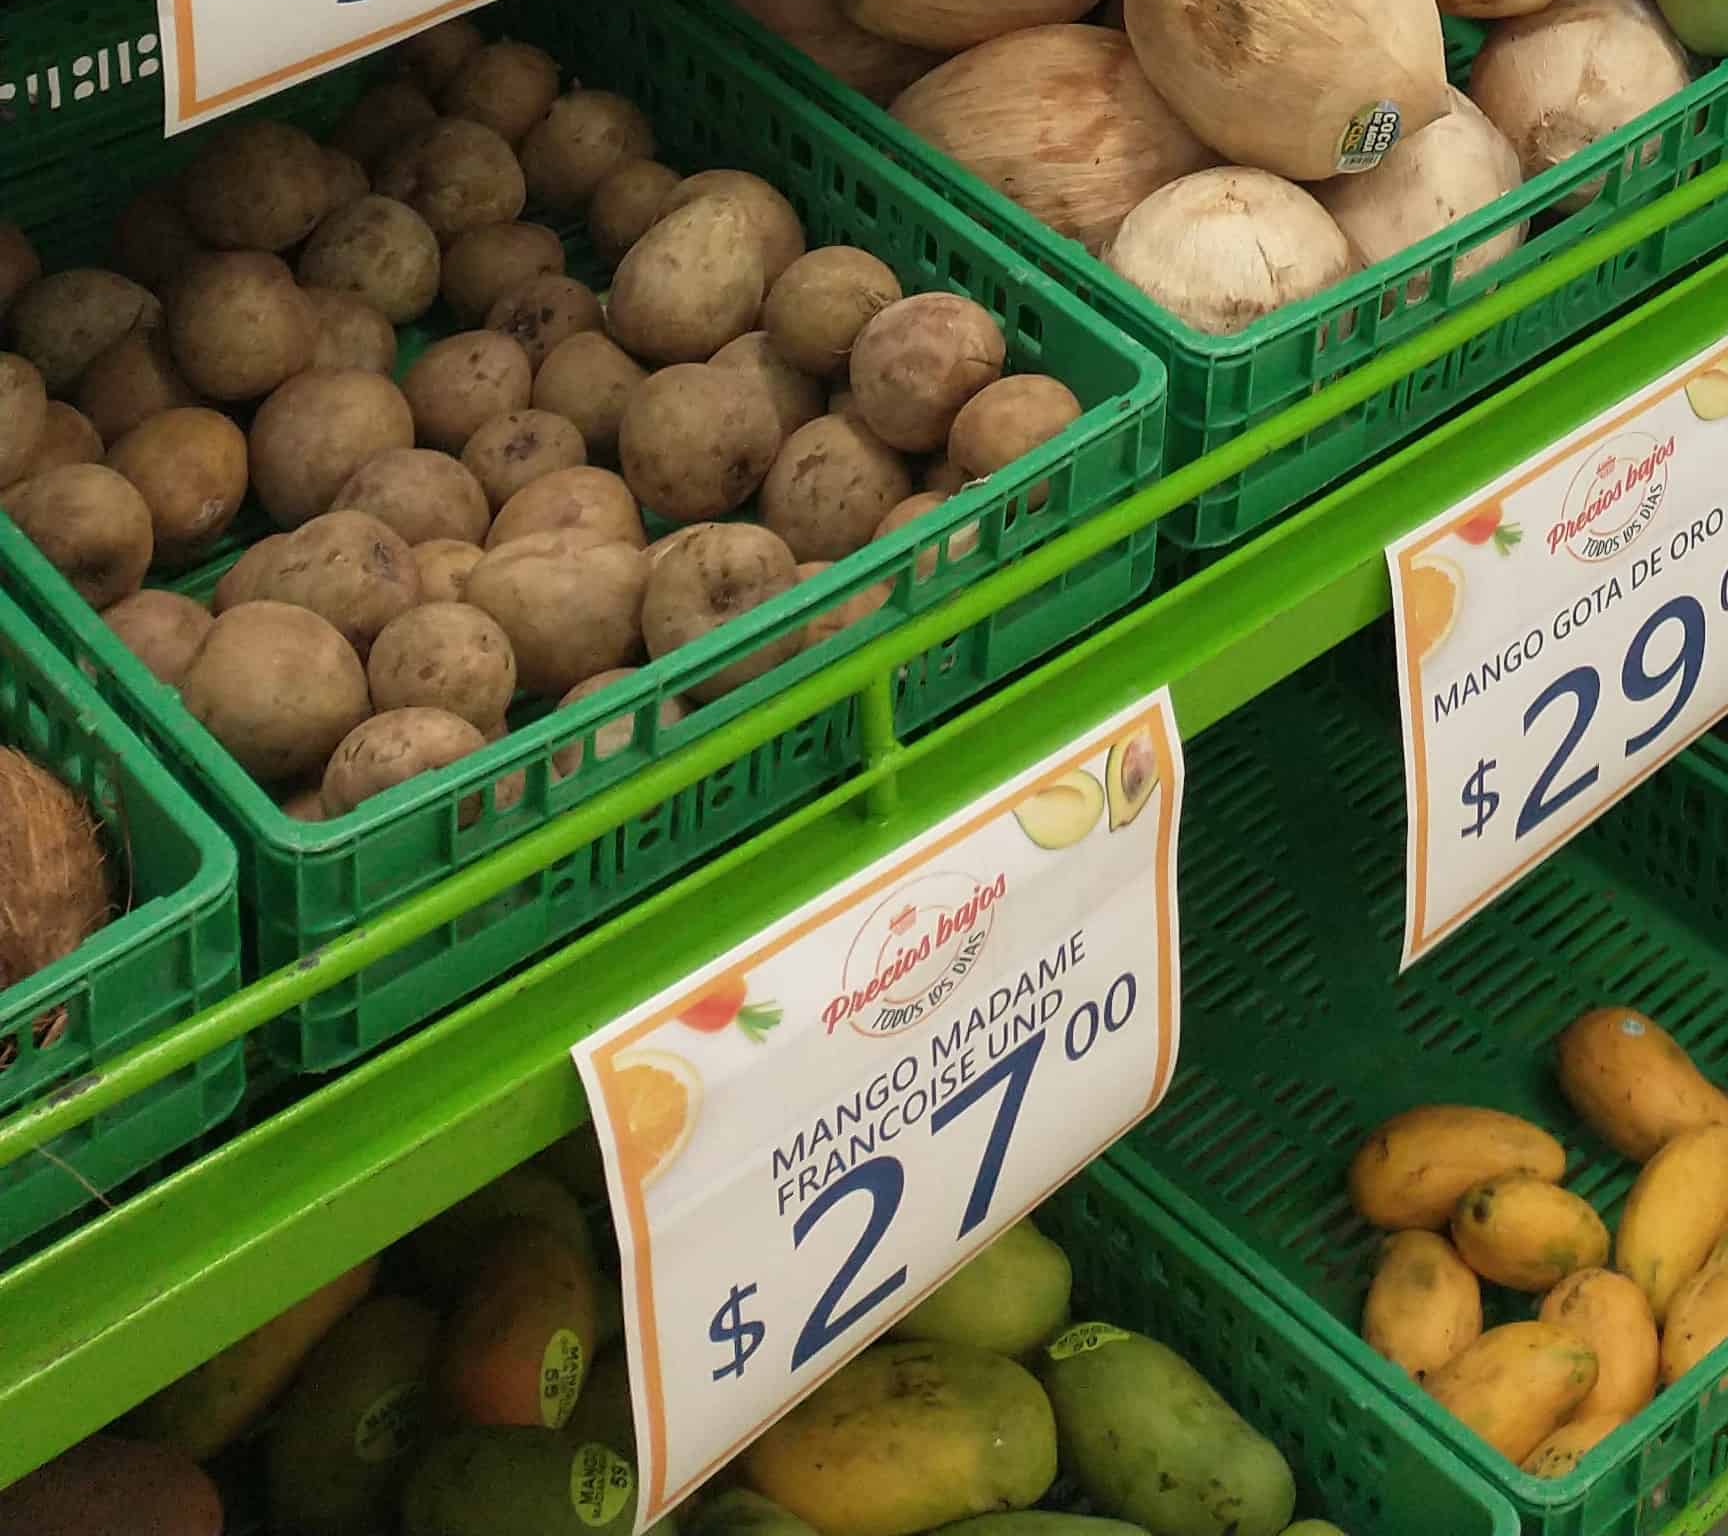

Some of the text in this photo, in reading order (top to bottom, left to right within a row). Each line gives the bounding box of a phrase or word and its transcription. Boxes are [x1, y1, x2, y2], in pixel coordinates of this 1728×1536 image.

[1375, 112, 1397, 151] COCO
[1433, 628, 1543, 724] MANGO
[1551, 583, 1623, 642] GOTA
[1630, 548, 1664, 596] DE
[1669, 507, 1724, 563] ORO
[1461, 758, 1499, 840] $
[1514, 594, 1705, 841] 29
[771, 929, 1088, 1181] MANGO MADAME
[775, 988, 1064, 1216] FRANCOISE UND
[708, 971, 1137, 1382] $ 27 00
